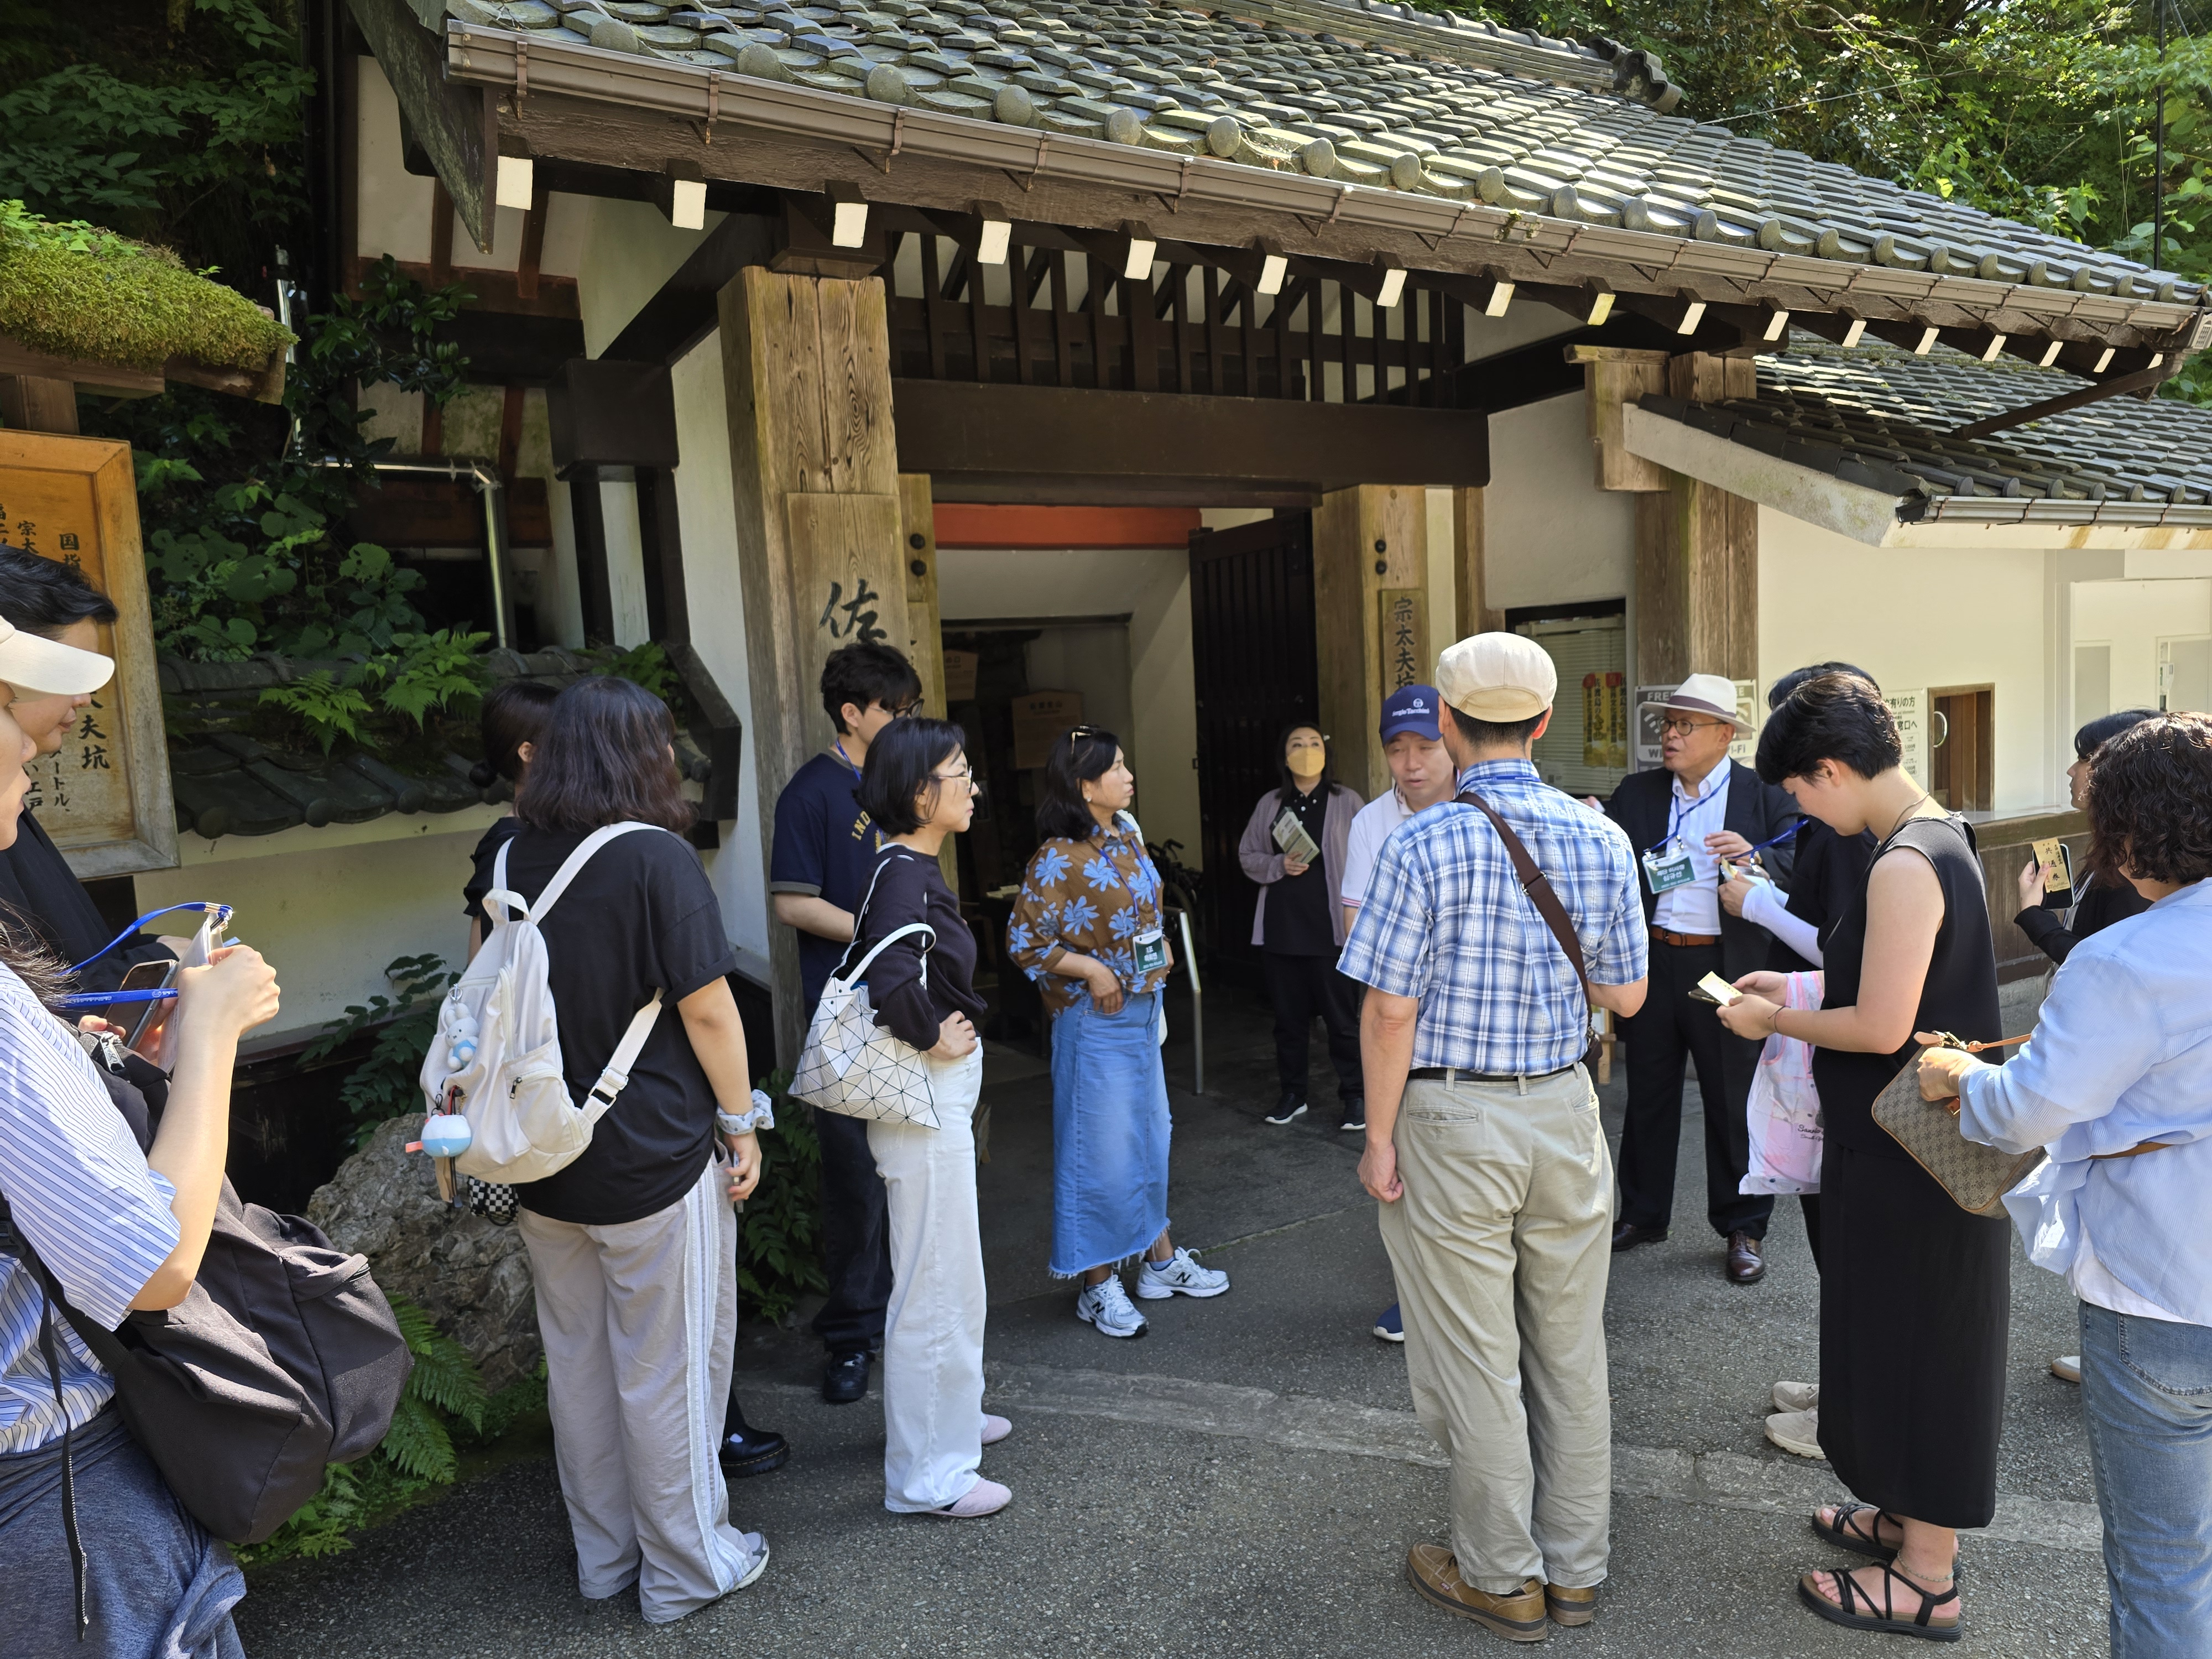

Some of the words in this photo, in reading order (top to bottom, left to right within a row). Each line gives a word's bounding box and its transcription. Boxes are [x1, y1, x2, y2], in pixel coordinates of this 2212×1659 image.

[818, 578, 888, 644] 佐
[1394, 596, 1416, 690] 宗太夫坑
[1728, 744, 1745, 754] I-FI
[852, 811, 871, 841] IND
